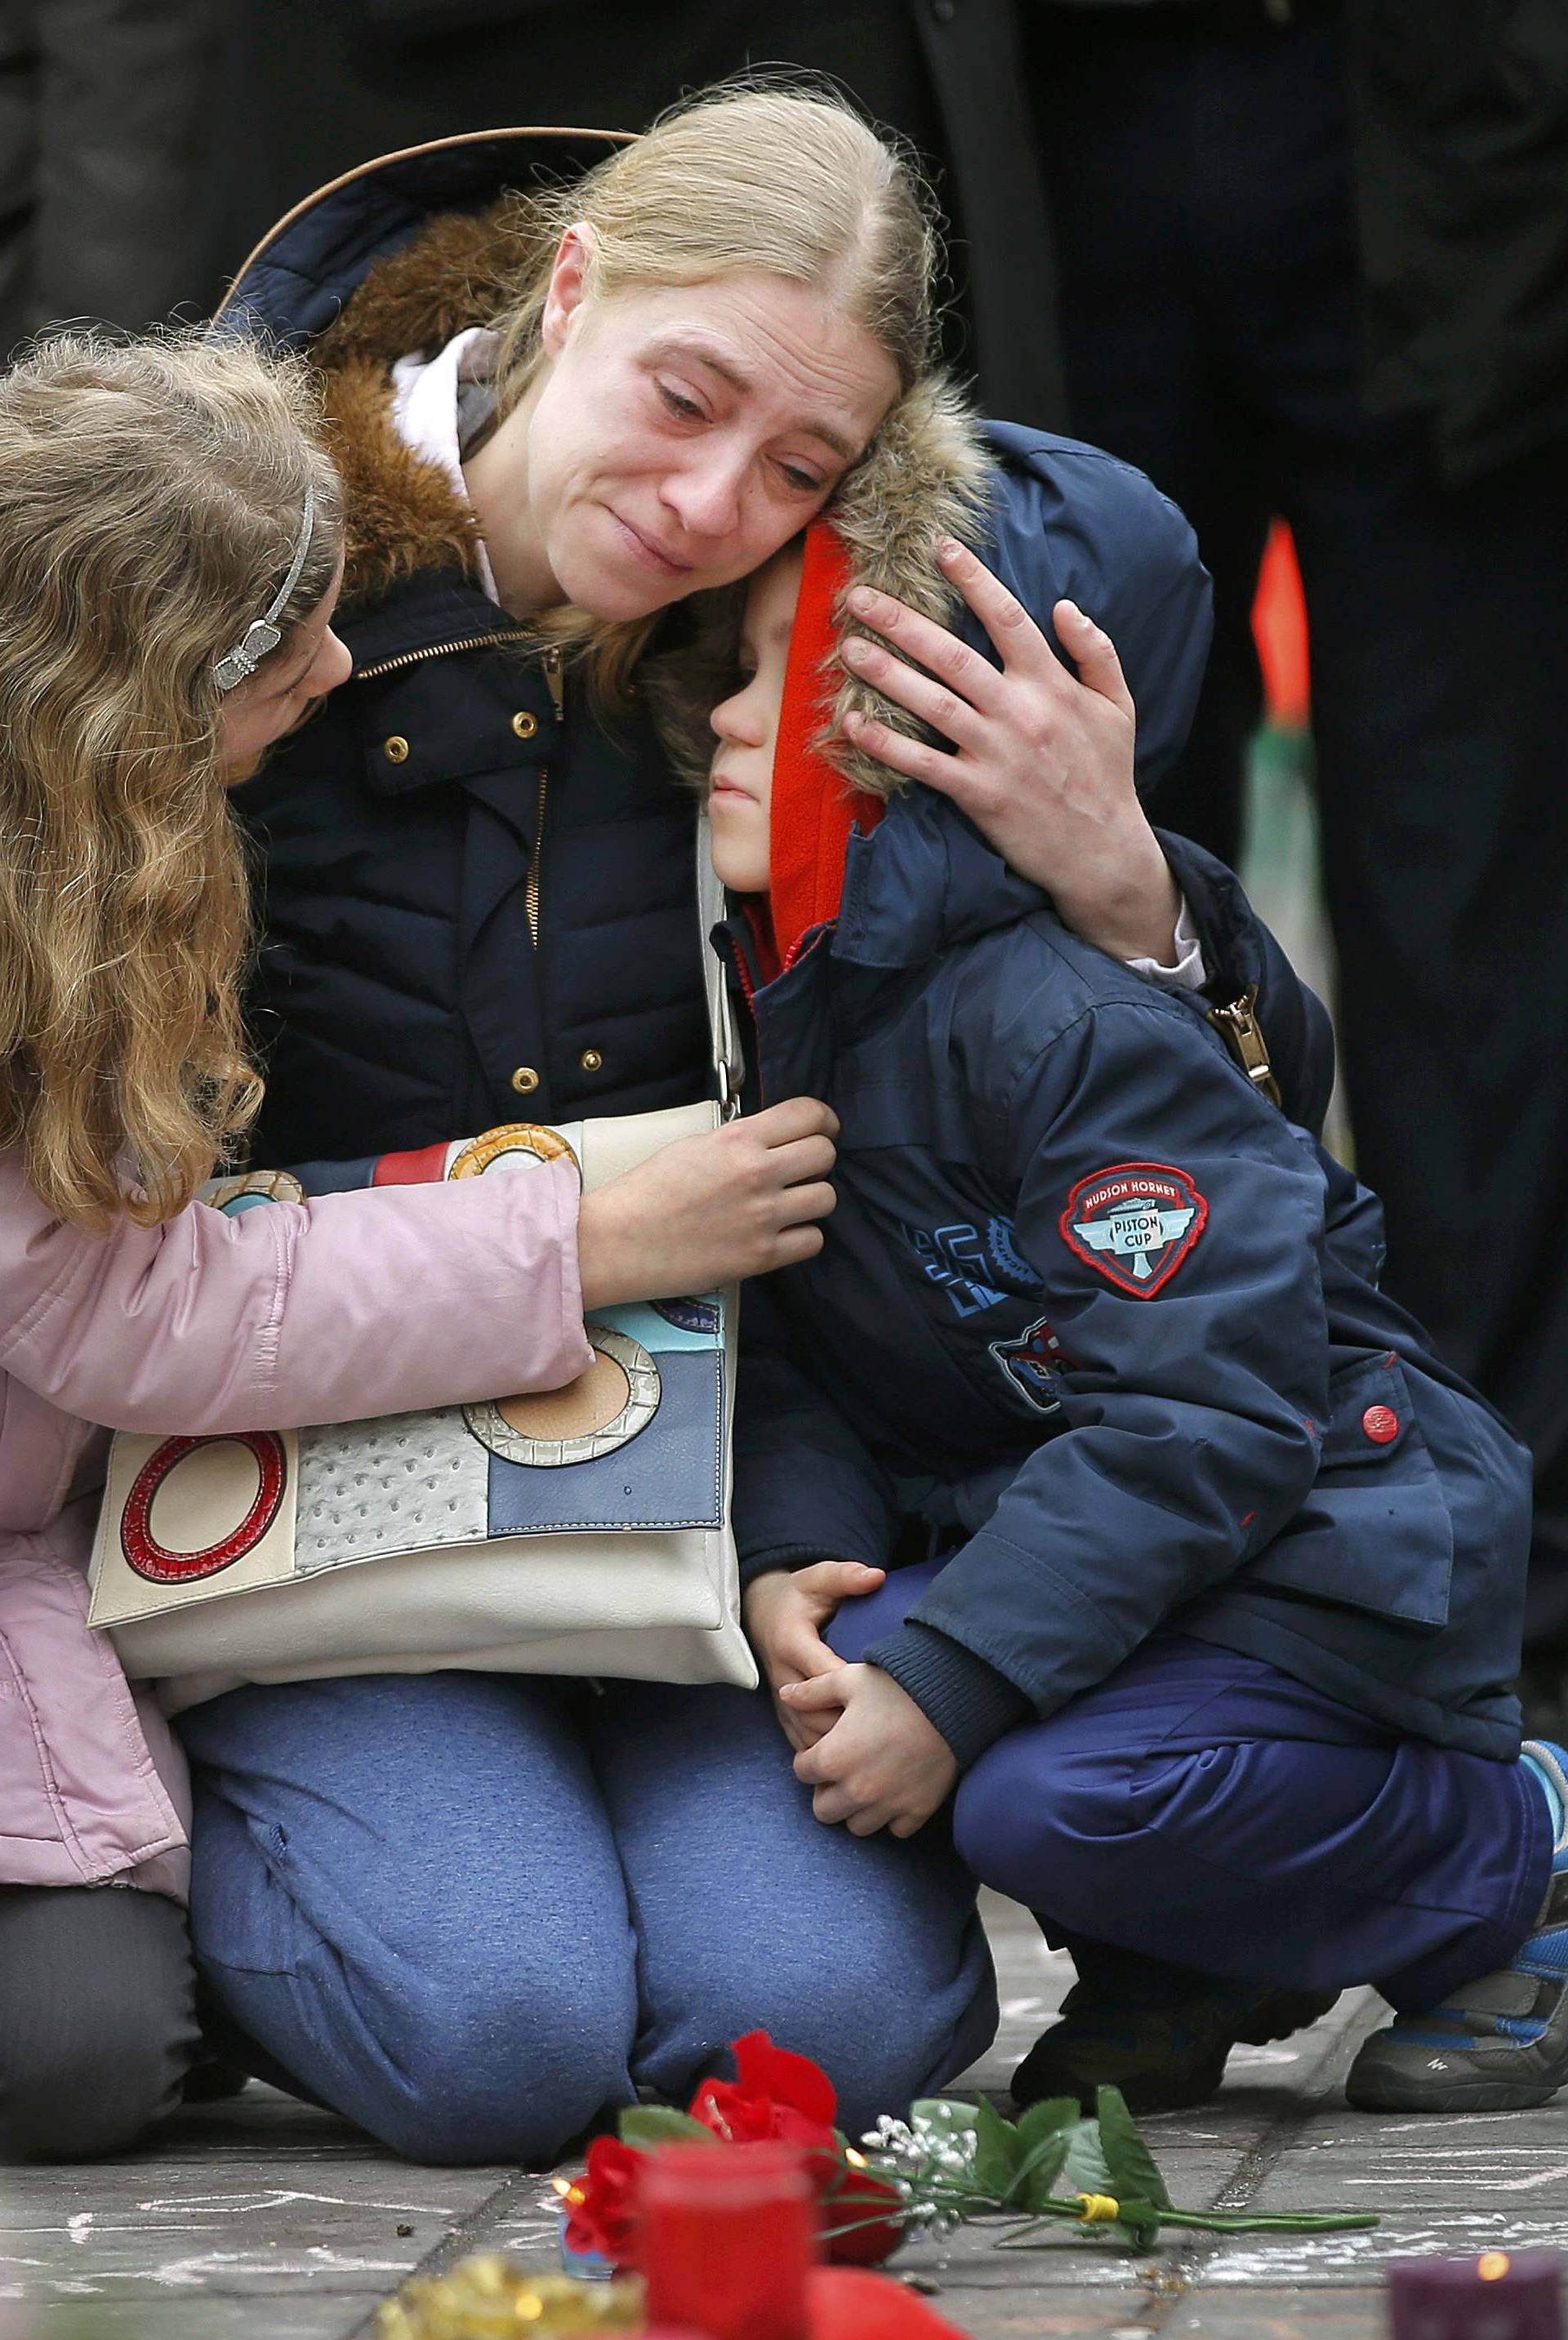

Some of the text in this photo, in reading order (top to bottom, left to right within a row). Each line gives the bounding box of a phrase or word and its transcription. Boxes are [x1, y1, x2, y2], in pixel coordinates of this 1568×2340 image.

[1085, 1181, 1176, 1209] HUDSON HORNET
[1115, 1215, 1158, 1234] PISTON
[1125, 1233, 1152, 1247] CUP
